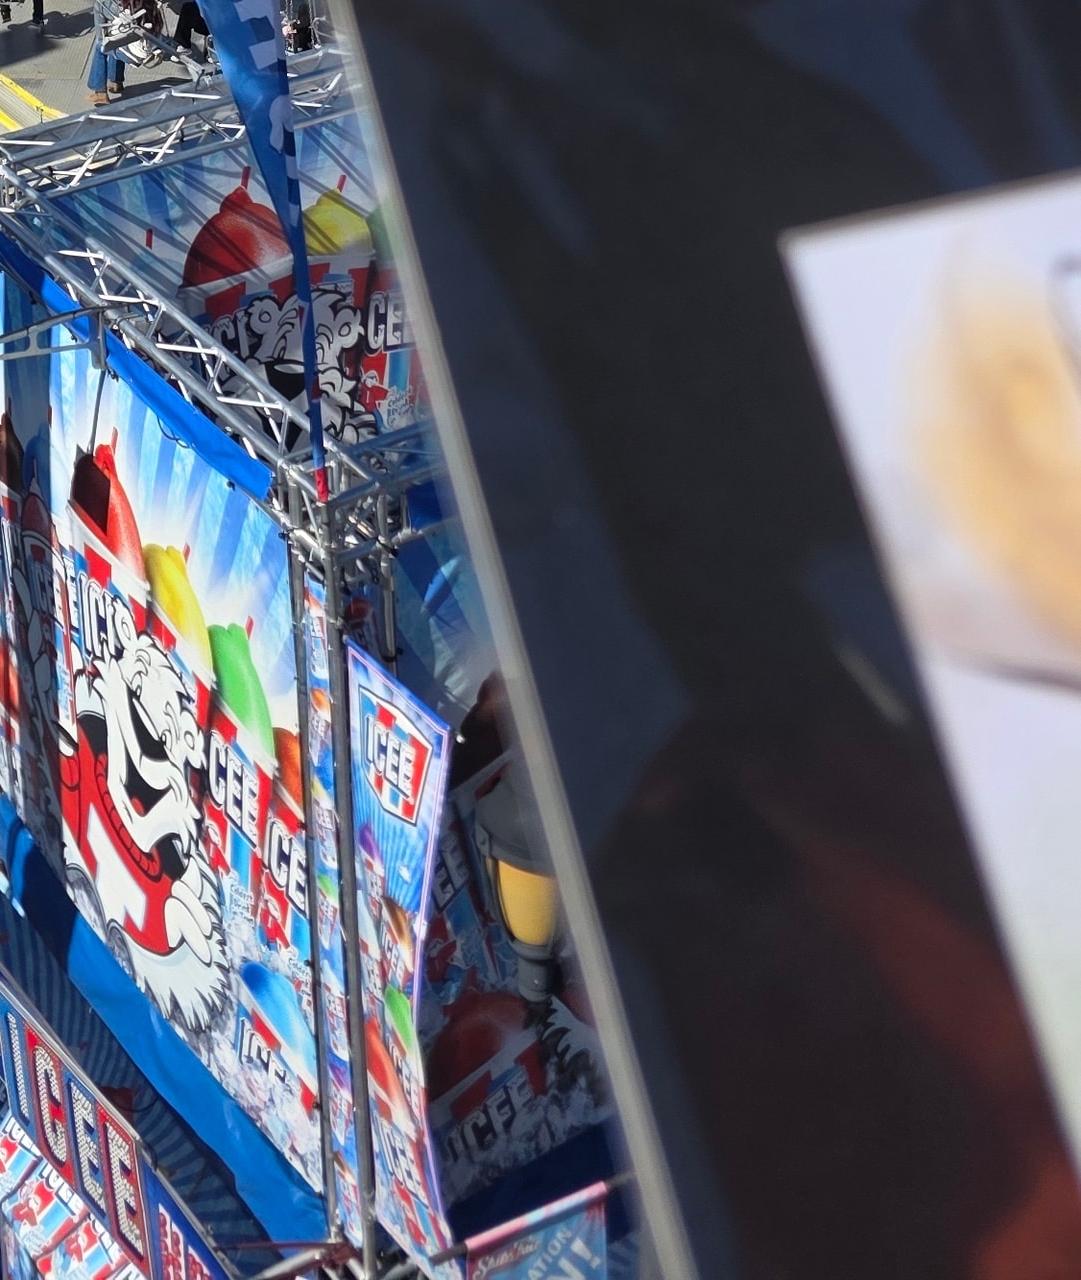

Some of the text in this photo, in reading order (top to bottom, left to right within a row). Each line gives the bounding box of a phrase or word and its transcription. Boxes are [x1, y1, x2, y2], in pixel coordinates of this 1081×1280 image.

[366, 716, 416, 798] ICEE
[6, 1011, 144, 1256] ICEE
[370, 1108, 430, 1209] ICEE
